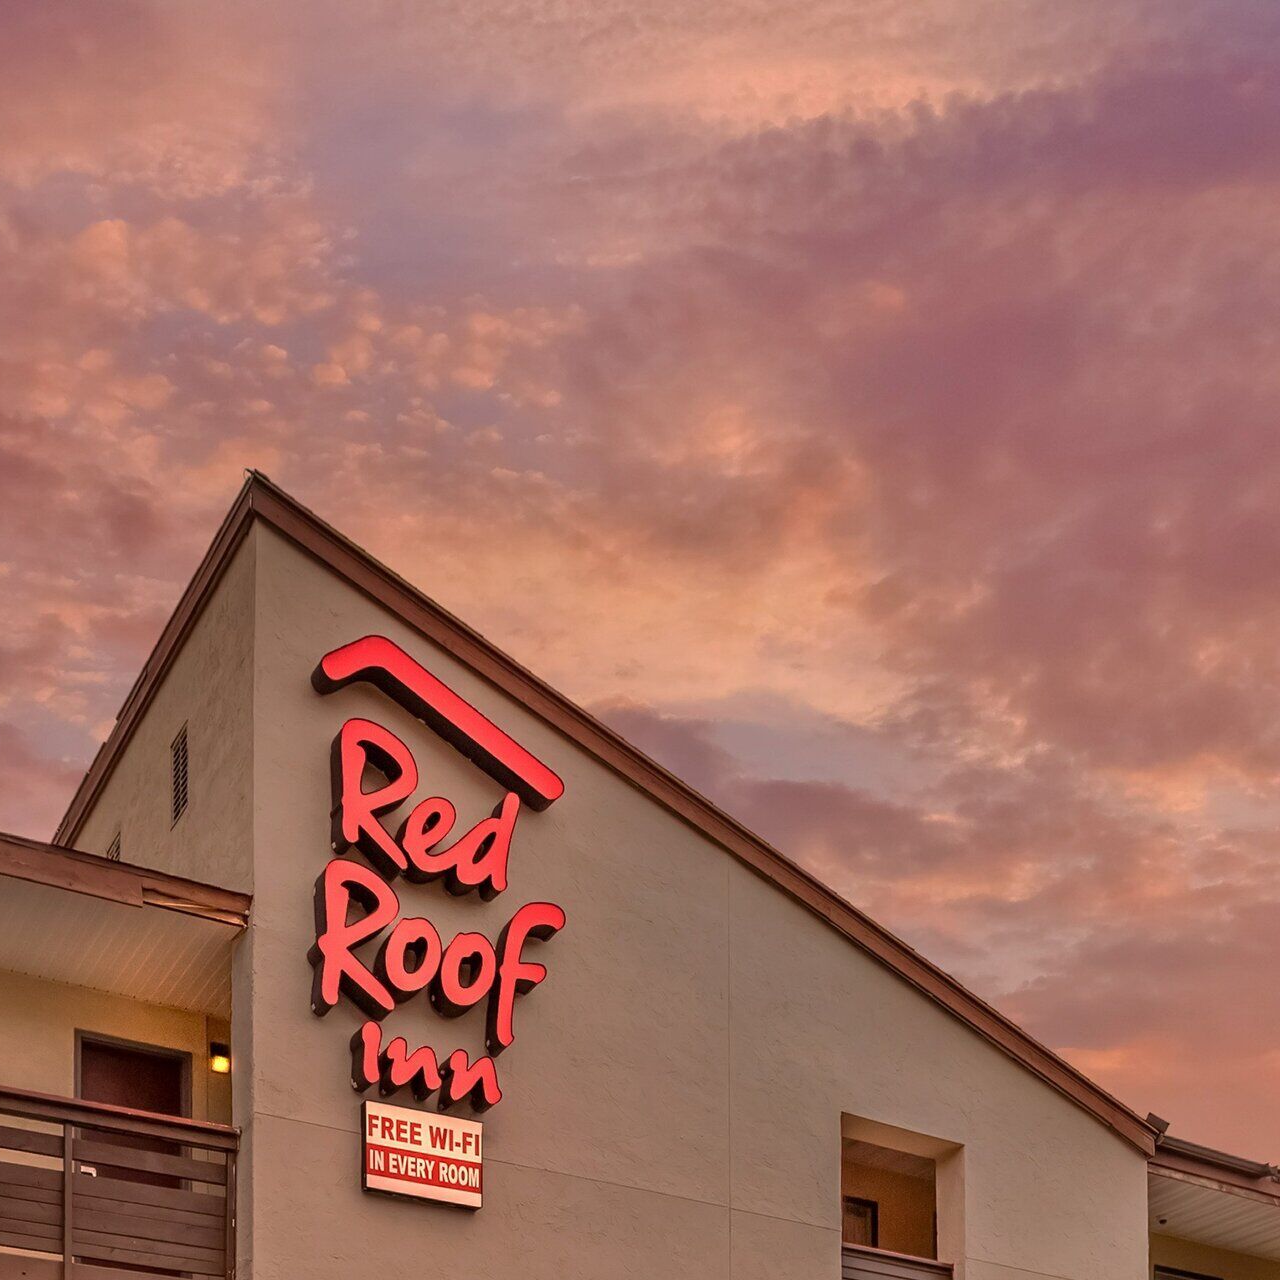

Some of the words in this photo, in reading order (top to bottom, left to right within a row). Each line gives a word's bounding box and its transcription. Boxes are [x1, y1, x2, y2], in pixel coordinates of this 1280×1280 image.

[336, 718, 520, 894] Red
[312, 859, 567, 1051] Roof
[367, 1113, 422, 1146] FREE
[428, 1125, 480, 1157] WI-FI
[369, 1148, 385, 1172] IN
[388, 1152, 435, 1180] EVERY
[439, 1161, 480, 1188] ROOM
